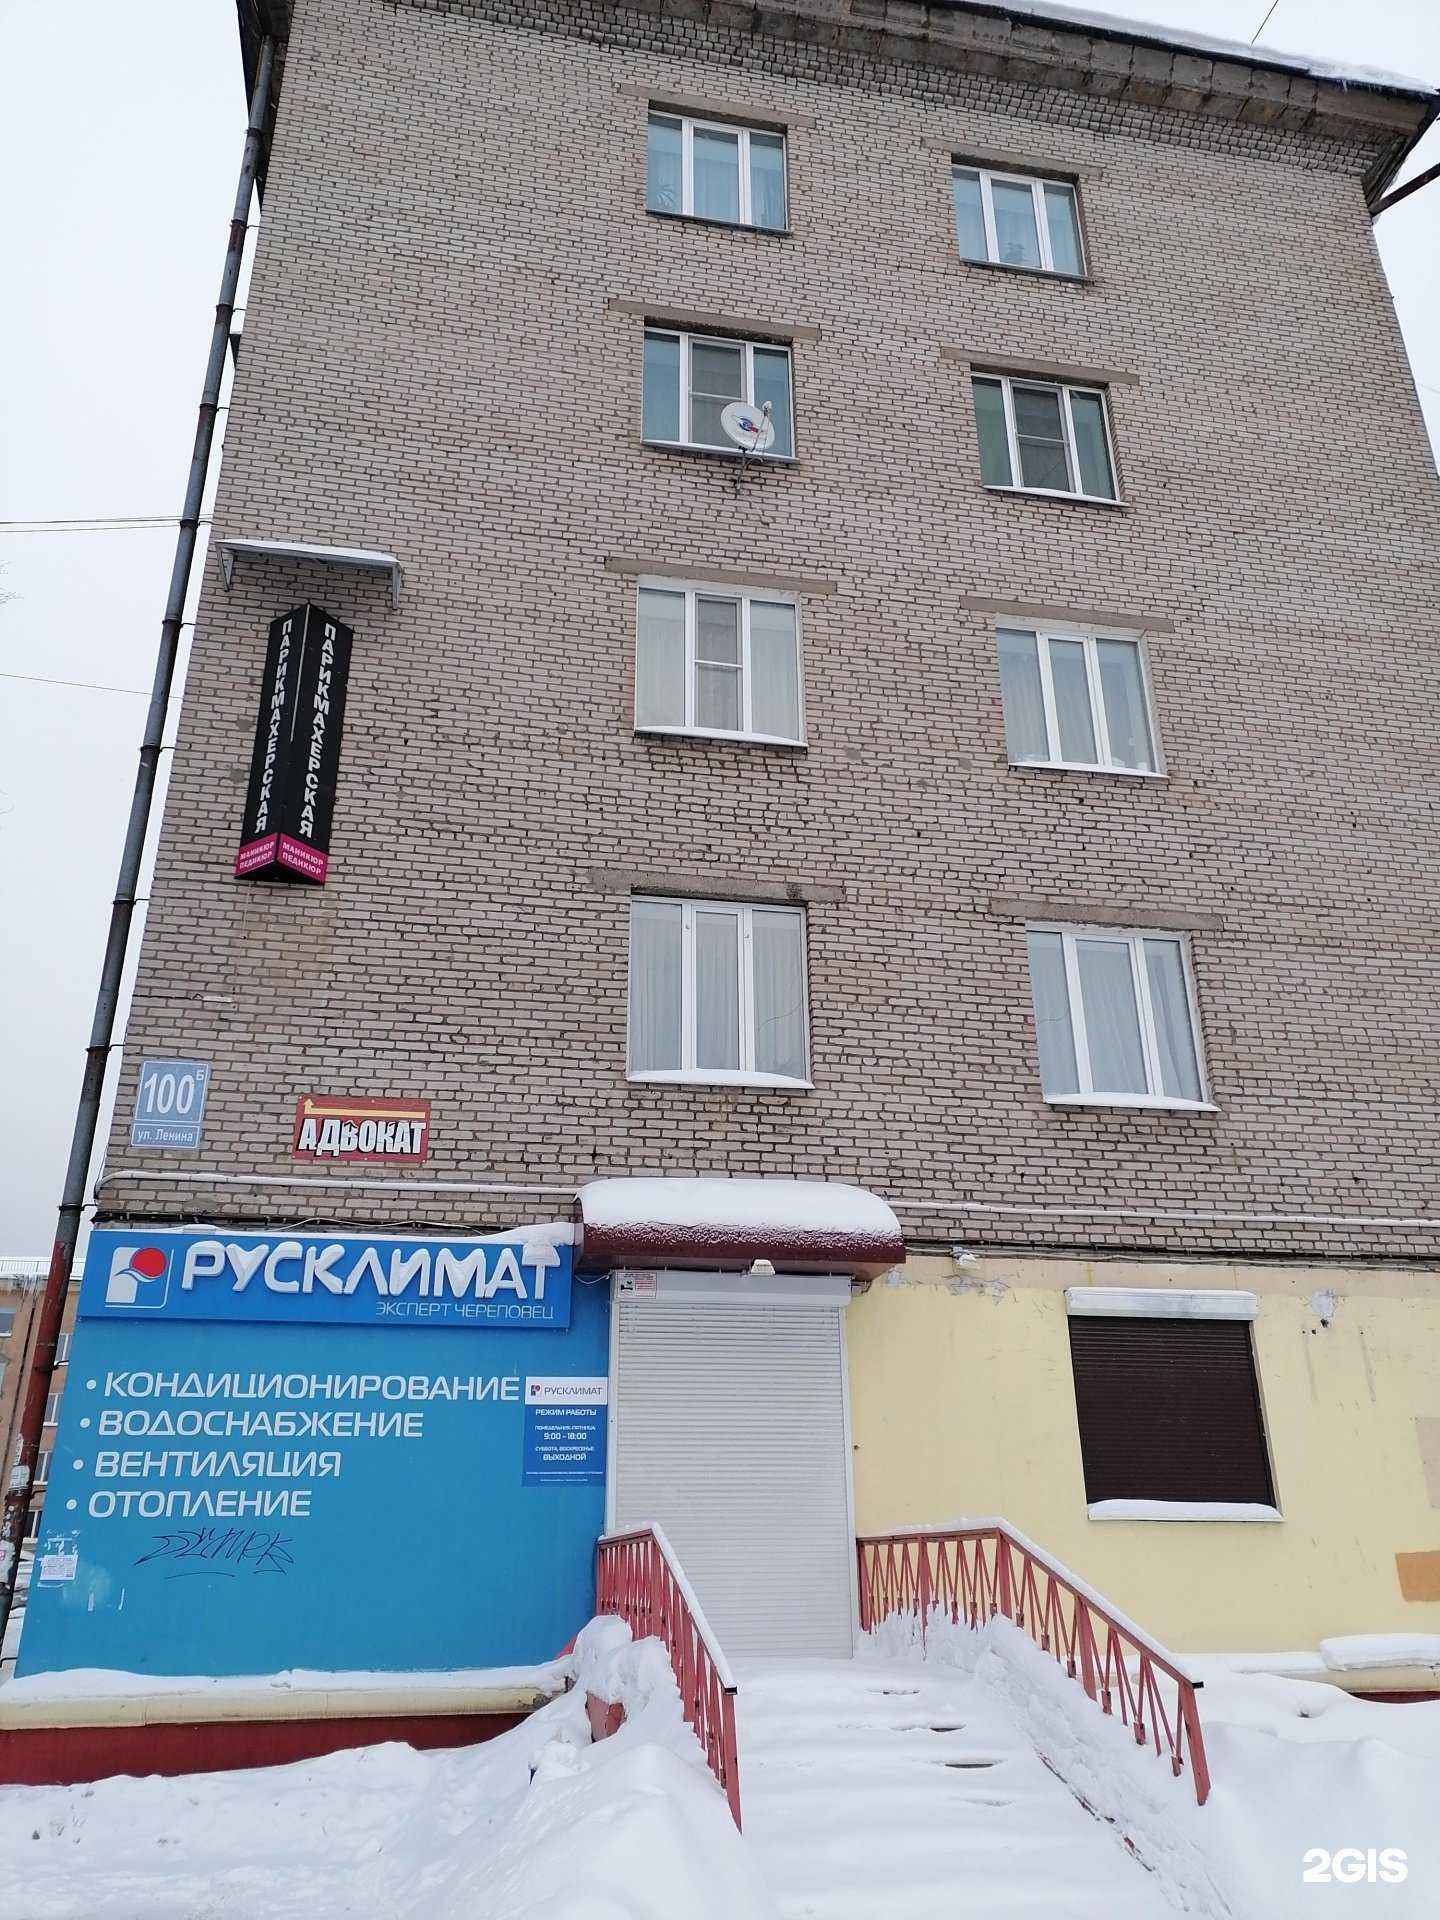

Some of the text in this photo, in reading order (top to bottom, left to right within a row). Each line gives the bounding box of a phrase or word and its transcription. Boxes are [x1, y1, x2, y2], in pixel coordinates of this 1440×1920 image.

[254, 618, 293, 834] ПАРИКМАХЕРСКАЯ
[299, 622, 337, 839] ПАРИКМАХЕРСКАЯ
[239, 851, 273, 869] ПЕДИКЮР
[240, 841, 275, 860] МАНИКЮР
[282, 842, 324, 866] МАНИКЮР
[282, 852, 322, 875] ПЕДИКЮР
[137, 1128, 194, 1143] ул. Ленина
[298, 1117, 427, 1157] АДВОКАТ
[181, 1240, 561, 1300] РУСКЛИМАТ
[375, 1301, 554, 1320] ЭКСПЕРТ ЧЕРЕПОВЕЦ
[103, 1371, 521, 1401] КОНДИЦИОНИРОВАНИЕ
[544, 1386, 603, 1396] РУСКЛИМАТ
[535, 1408, 597, 1416] РЕЖИМ РАБОТЫ
[98, 1410, 424, 1438] ВОДОСНАБЖЕНИЕ
[543, 1432, 561, 1440] 9:00
[94, 1450, 342, 1478] ВЕНТИЛЯЦИЯ
[542, 1453, 587, 1461] ВЫХОДНОЙ
[87, 1489, 313, 1519] ОТОПЛЕНИЕ
